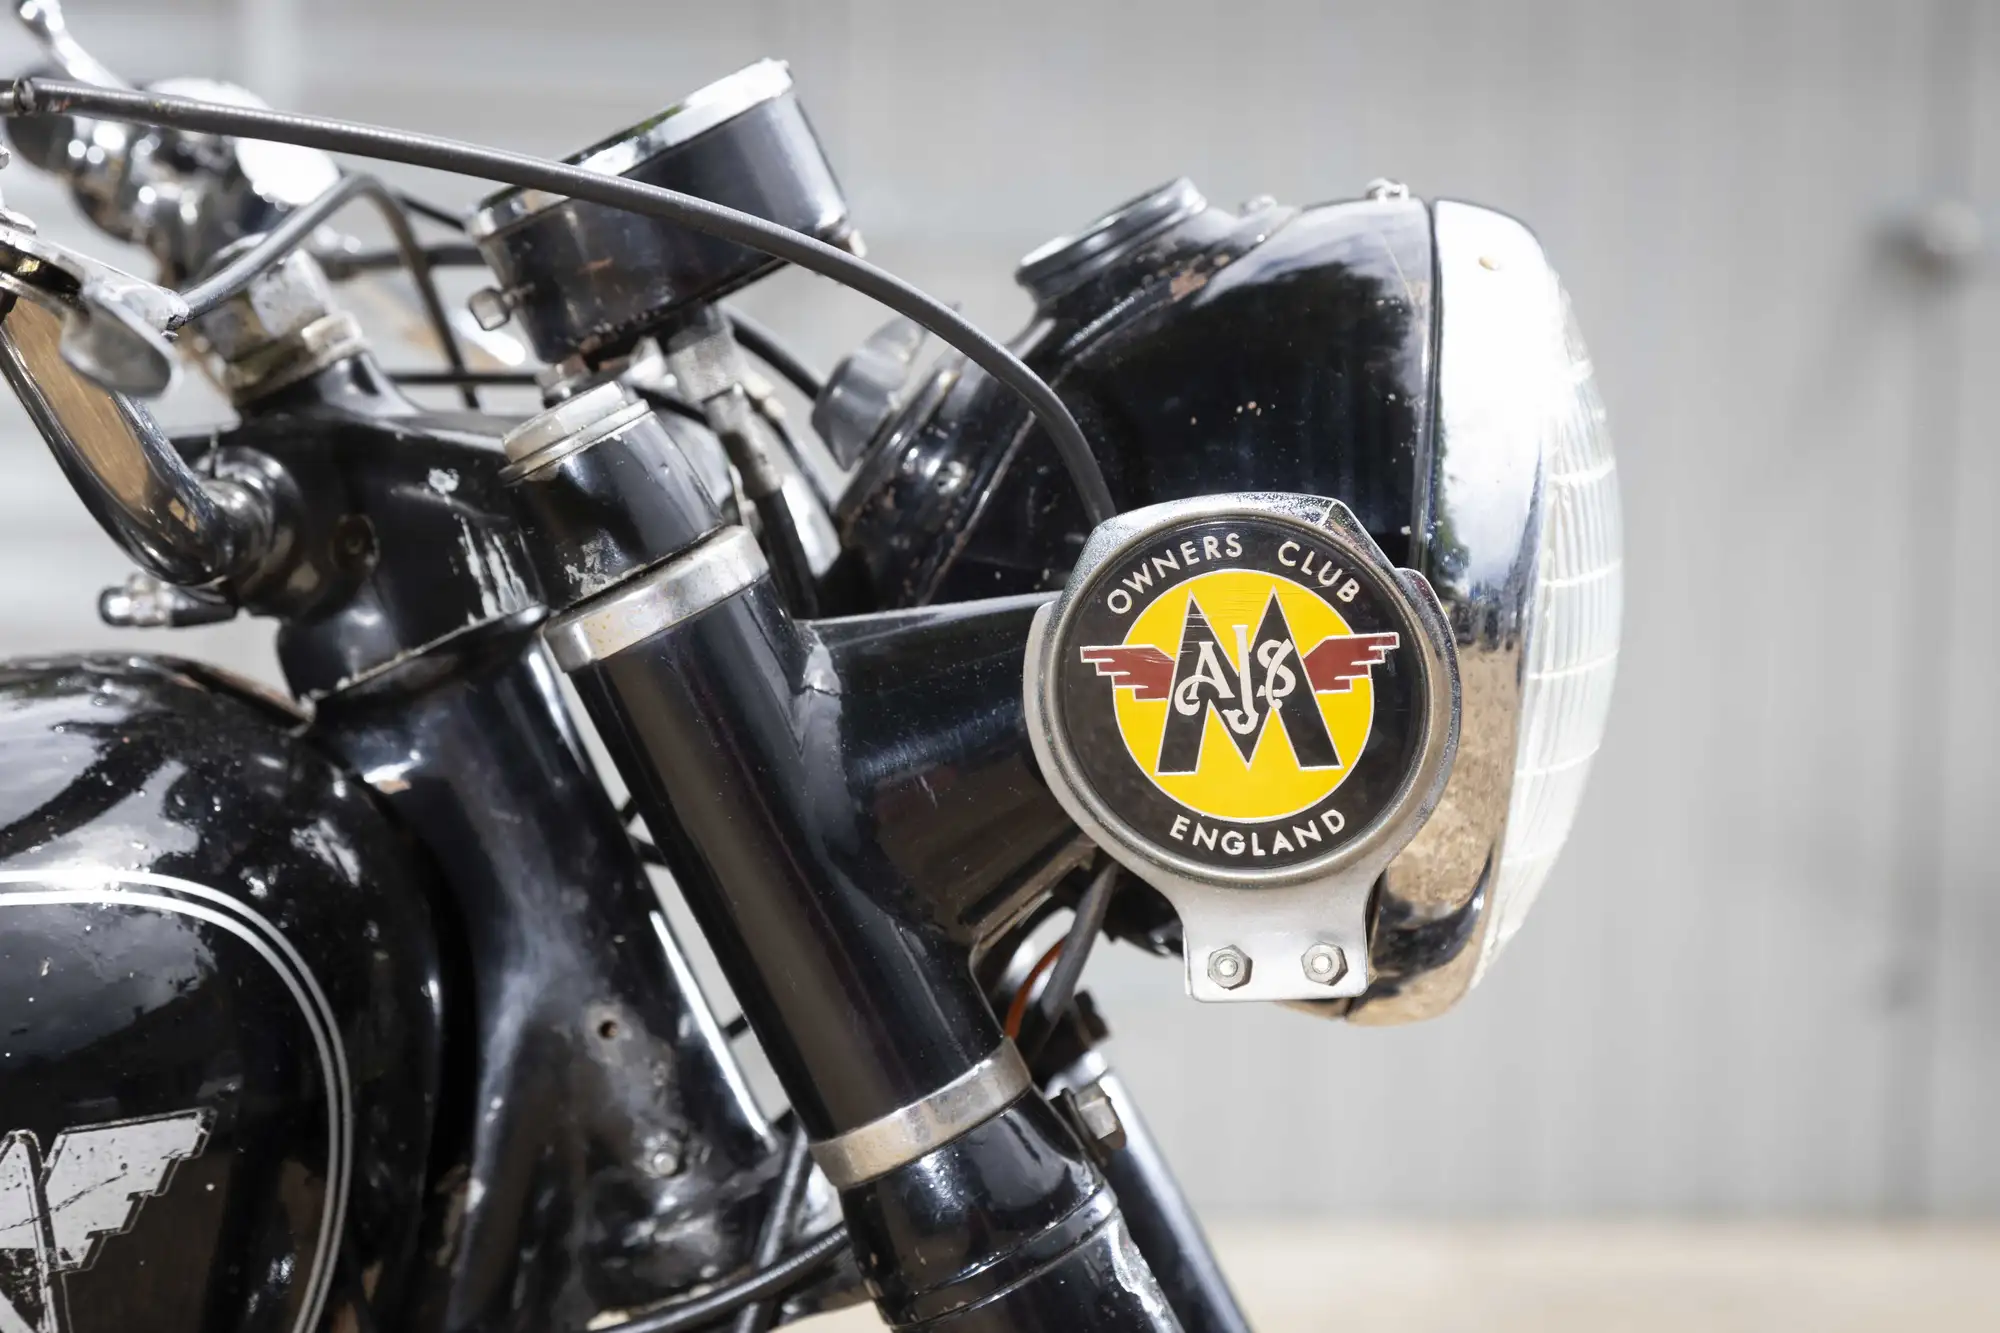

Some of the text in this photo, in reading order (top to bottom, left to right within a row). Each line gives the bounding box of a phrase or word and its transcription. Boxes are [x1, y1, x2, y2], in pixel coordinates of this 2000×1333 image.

[1107, 533, 1361, 614] OWNERS CLUB
[1175, 625, 1296, 735] AJS
[1169, 809, 1346, 857] ENGLAND
